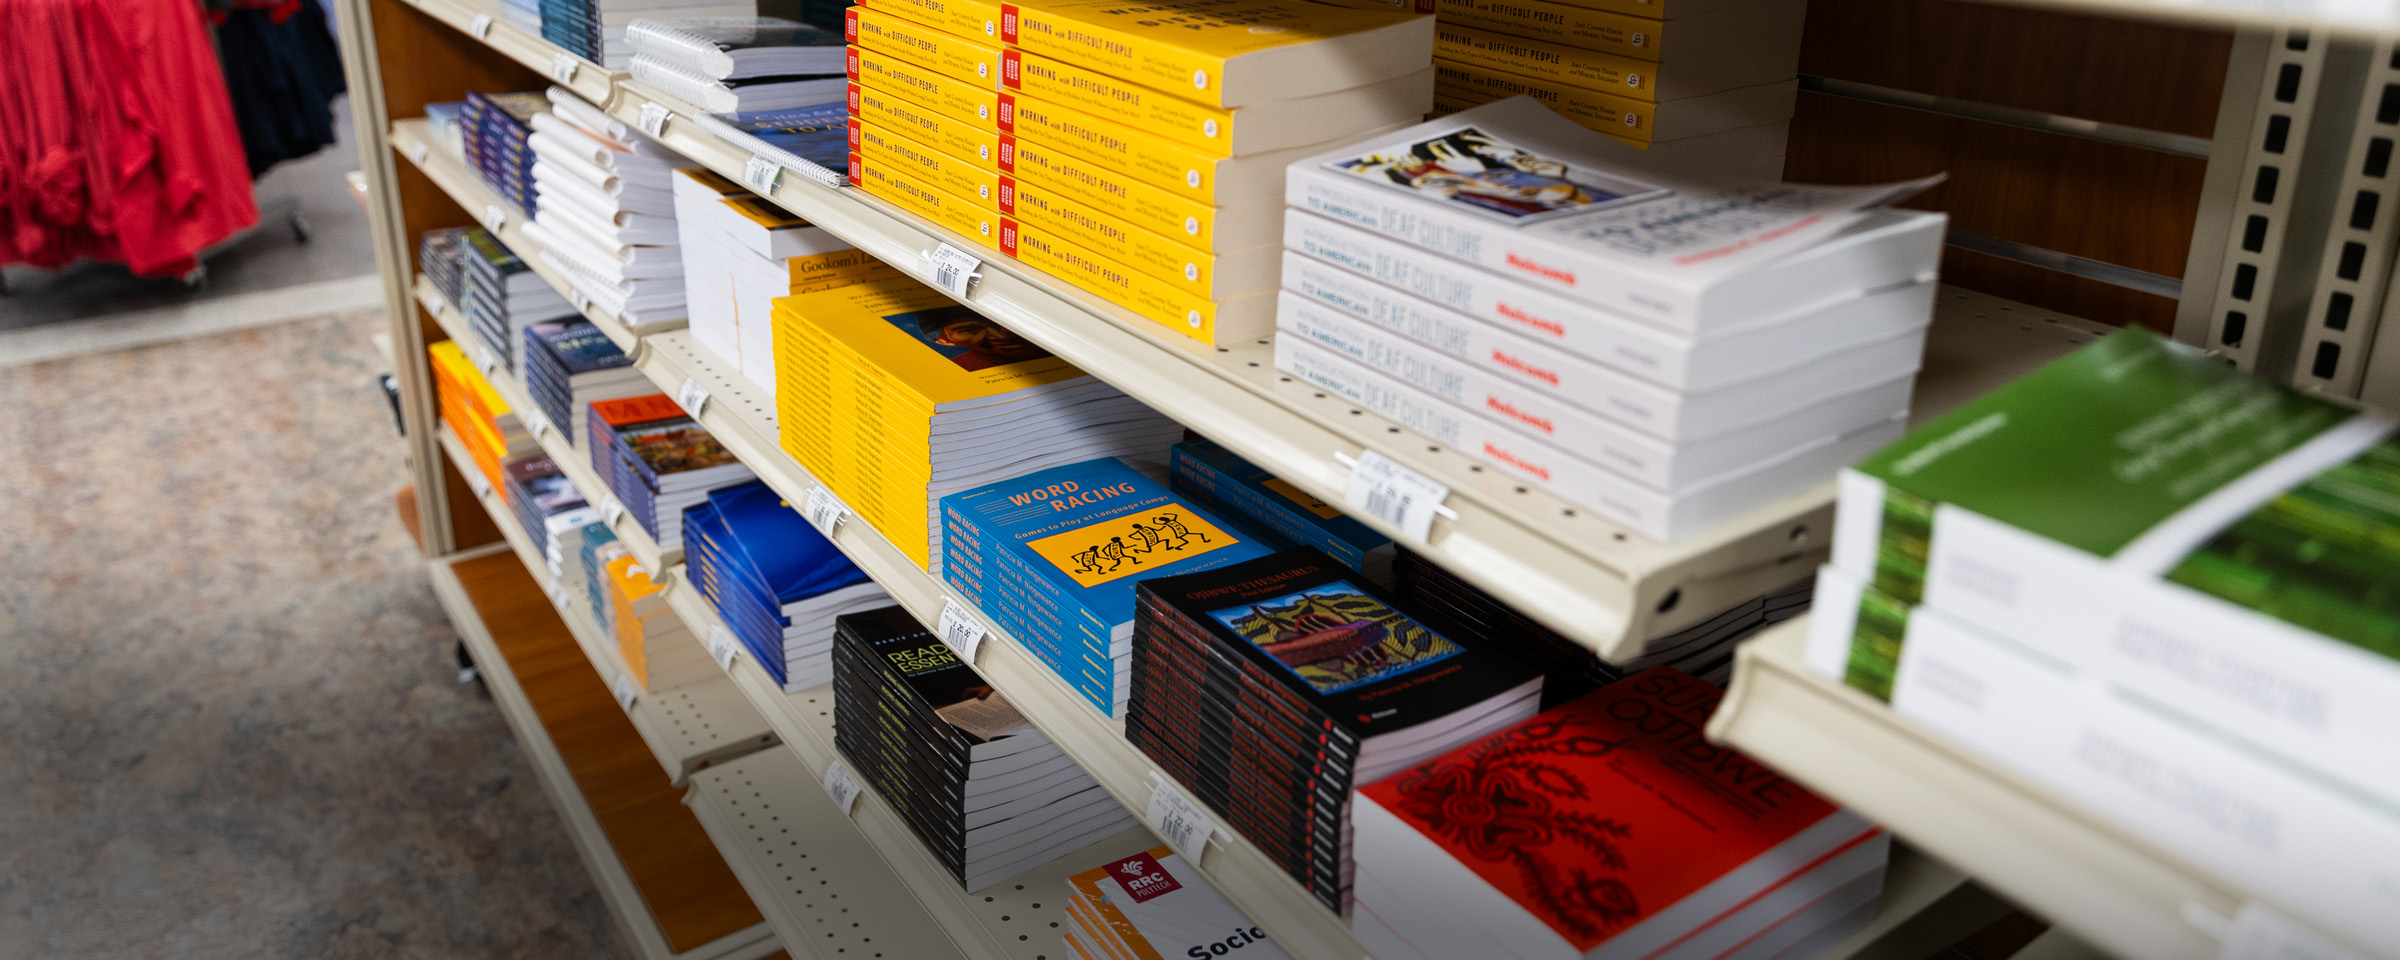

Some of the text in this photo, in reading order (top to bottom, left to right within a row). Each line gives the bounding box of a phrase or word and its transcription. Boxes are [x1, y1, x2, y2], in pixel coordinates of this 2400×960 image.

[1492, 3, 1531, 18] DIFFICULT
[1534, 11, 1564, 25] PEOPLE
[862, 21, 882, 36] WORKING
[892, 31, 917, 46] DIFFICULT
[918, 40, 937, 54] PEOPLE
[1023, 18, 1132, 59] WORKING with DIFFICULT PEOPLE
[1439, 31, 1472, 46] WORKING
[1488, 42, 1527, 57] DIFFICULT
[1530, 50, 1560, 65] PEOPLE
[862, 59, 883, 74] WORKING
[893, 70, 918, 87] DIFFICULT
[919, 80, 938, 94] PEOPLE
[1026, 64, 1140, 106] WORKING with DIFFICULT PEOPLE
[1438, 67, 1470, 82] WORKING
[1487, 77, 1526, 94] DIFFICULT
[1528, 86, 1558, 102] PEOPLE
[864, 96, 884, 111] WORKING
[894, 107, 918, 124] DIFFICULT
[920, 117, 939, 133] PEOPLE
[1020, 108, 1127, 154] WORKING with DIFFICULT PEOPLE
[864, 132, 884, 147] WORKING
[894, 144, 918, 162] DIFFICULT
[920, 155, 939, 171] PEOPLE
[865, 166, 885, 182] WORKING
[895, 179, 919, 197] DIFFICULT
[921, 191, 940, 207] PEOPLE
[1020, 149, 1126, 199] WORKING with DIFFICULT PEOPLE
[1020, 191, 1126, 244] WORKING with DIFFICULT PEOPLE
[1381, 204, 1481, 264] DEAF CULTURE
[801, 253, 859, 274] Gookom's
[1022, 234, 1129, 289] WORKING with DIFFICULT PEOPLE
[1376, 250, 1473, 312] DEAF CULTURE
[1505, 250, 1576, 286] Holcomb
[1372, 296, 1469, 357] DEAF CULTURE
[1497, 300, 1566, 338] Holcomb
[1366, 338, 1463, 400] DEAF CULTURE
[1491, 348, 1560, 387] Holcomb
[1364, 382, 1460, 446] DEAF CULTURE
[1486, 394, 1554, 434] Holcomb
[1483, 441, 1551, 482] Holcomb
[1008, 481, 1079, 508] WORD
[1050, 482, 1136, 512] RACING
[1179, 454, 1195, 468] WORD
[1196, 461, 1216, 480] RACING
[1265, 501, 1304, 529] Ningewance
[1014, 526, 1046, 539] Games
[1049, 523, 1058, 531] to
[1060, 515, 1081, 528] Play
[1095, 501, 1139, 519] Language
[1139, 495, 1169, 507] Camps
[947, 507, 961, 523] WORD
[961, 517, 980, 538] RACING
[996, 543, 1016, 564] Patricia
[1025, 564, 1060, 597] Ningewance
[949, 520, 962, 537] WORD
[963, 531, 980, 551] RACING
[996, 557, 1016, 579] Patricia
[1024, 579, 1058, 612] Ningewance
[1176, 557, 1229, 577] Ningewance
[950, 534, 964, 551] WORD
[964, 545, 982, 566] RACING
[999, 572, 1018, 593] Patricia
[1028, 594, 1062, 627] Ningewance
[950, 548, 964, 564] WORD
[964, 559, 982, 579] RACING
[999, 586, 1018, 607] Patricia
[1028, 609, 1062, 641] Ningewance
[1237, 565, 1320, 591] THESAURUS
[950, 562, 964, 579] WORD
[964, 573, 982, 593] RACING
[999, 600, 1018, 623] Patricia
[1027, 623, 1061, 657] Ningewance
[950, 575, 964, 592] WORD
[964, 587, 982, 608] RACING
[999, 615, 1018, 636] Patricia
[1027, 638, 1061, 671] Ningewance
[957, 624, 971, 638] 20.00
[1127, 872, 1164, 891] RRC
[1136, 880, 1171, 898] POLYTECH
[1187, 926, 1266, 960] Socio
